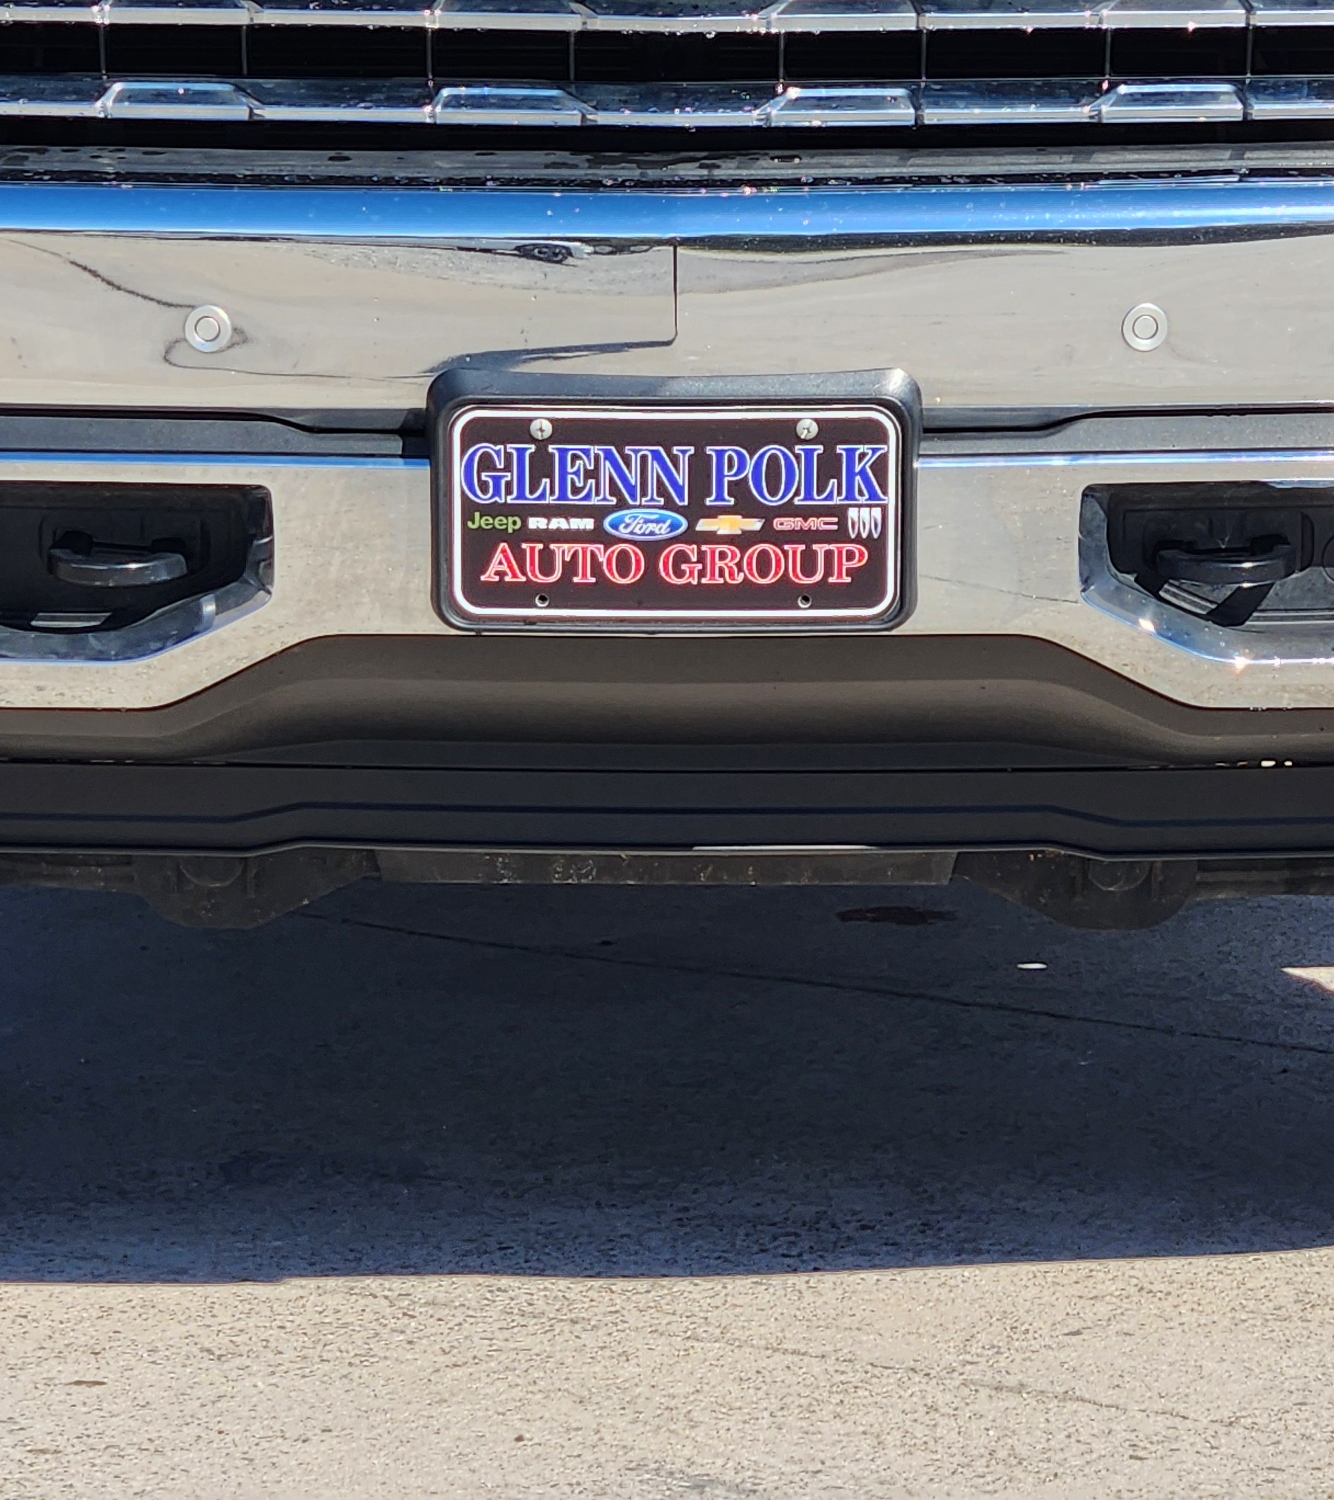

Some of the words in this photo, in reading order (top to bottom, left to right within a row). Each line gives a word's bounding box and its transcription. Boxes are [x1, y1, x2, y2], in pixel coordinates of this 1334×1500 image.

[461, 443, 694, 505] GLENN
[705, 444, 889, 506] POLK
[467, 512, 522, 534] Jeep
[527, 516, 595, 531] RAM
[772, 516, 839, 531] GMC
[480, 542, 646, 584] AUTO
[659, 542, 870, 585] GROUP
